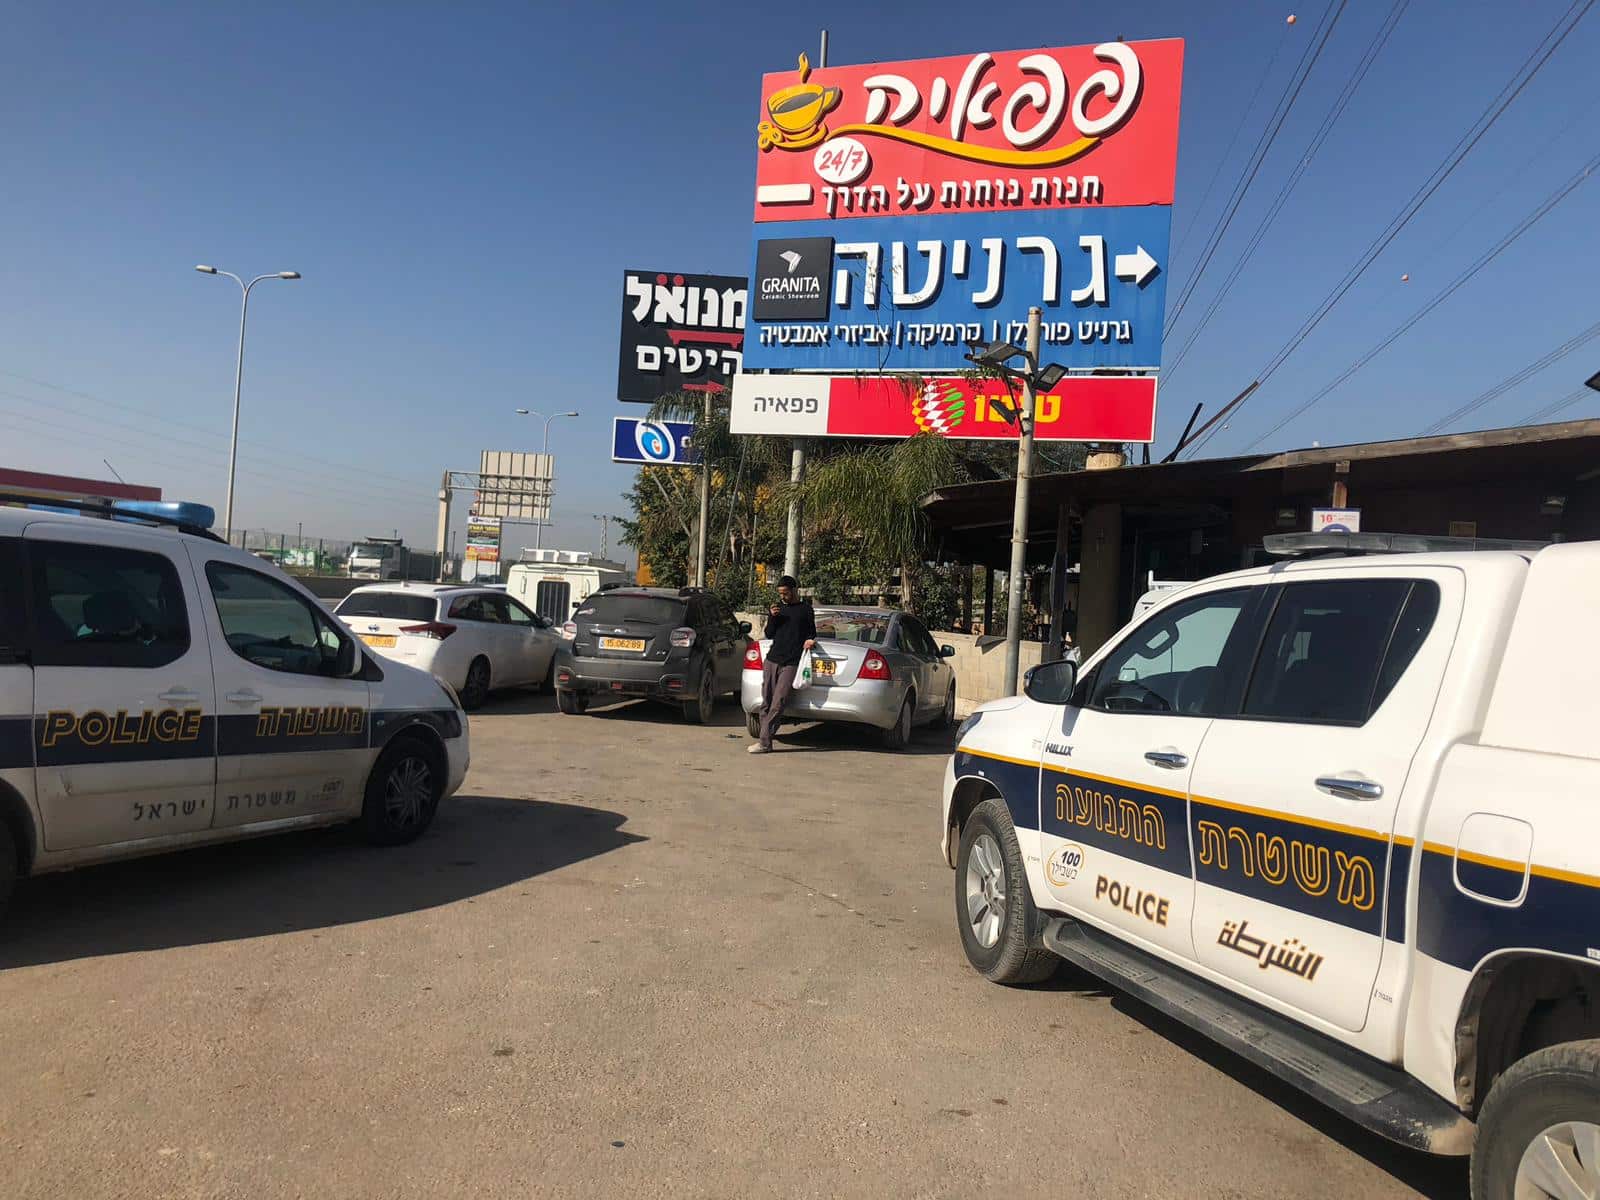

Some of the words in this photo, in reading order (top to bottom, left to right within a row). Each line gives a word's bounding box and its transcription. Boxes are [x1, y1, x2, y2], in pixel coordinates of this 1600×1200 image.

[863, 42, 1142, 147] פפאיה
[818, 148, 865, 177] 24/7
[821, 183, 887, 216] הדרך
[897, 177, 932, 207] על
[939, 178, 1021, 205] נוחות
[1030, 175, 1101, 202] חנות
[761, 276, 821, 293] GRANITA
[834, 235, 1108, 307] גרניטה
[626, 274, 748, 329] מנואל
[760, 324, 828, 344] אמבטיה
[834, 324, 890, 343] אביזרי
[906, 322, 981, 346] קרמיקה
[1005, 319, 1072, 345] פורלן
[1078, 319, 1131, 342] גרניט
[753, 396, 819, 414] פפאיה
[974, 394, 1062, 423] טטו
[42, 707, 202, 747] POLICE
[255, 705, 368, 737] משטרה
[1045, 742, 1074, 757] HILUX
[133, 799, 207, 821] ישראל
[226, 789, 297, 810] משטרת
[1055, 782, 1167, 850] התנועה
[1061, 850, 1081, 867] 100
[1199, 820, 1376, 912] משטרת
[1095, 874, 1170, 928] POLICE
[1217, 920, 1325, 982] الشرطة
